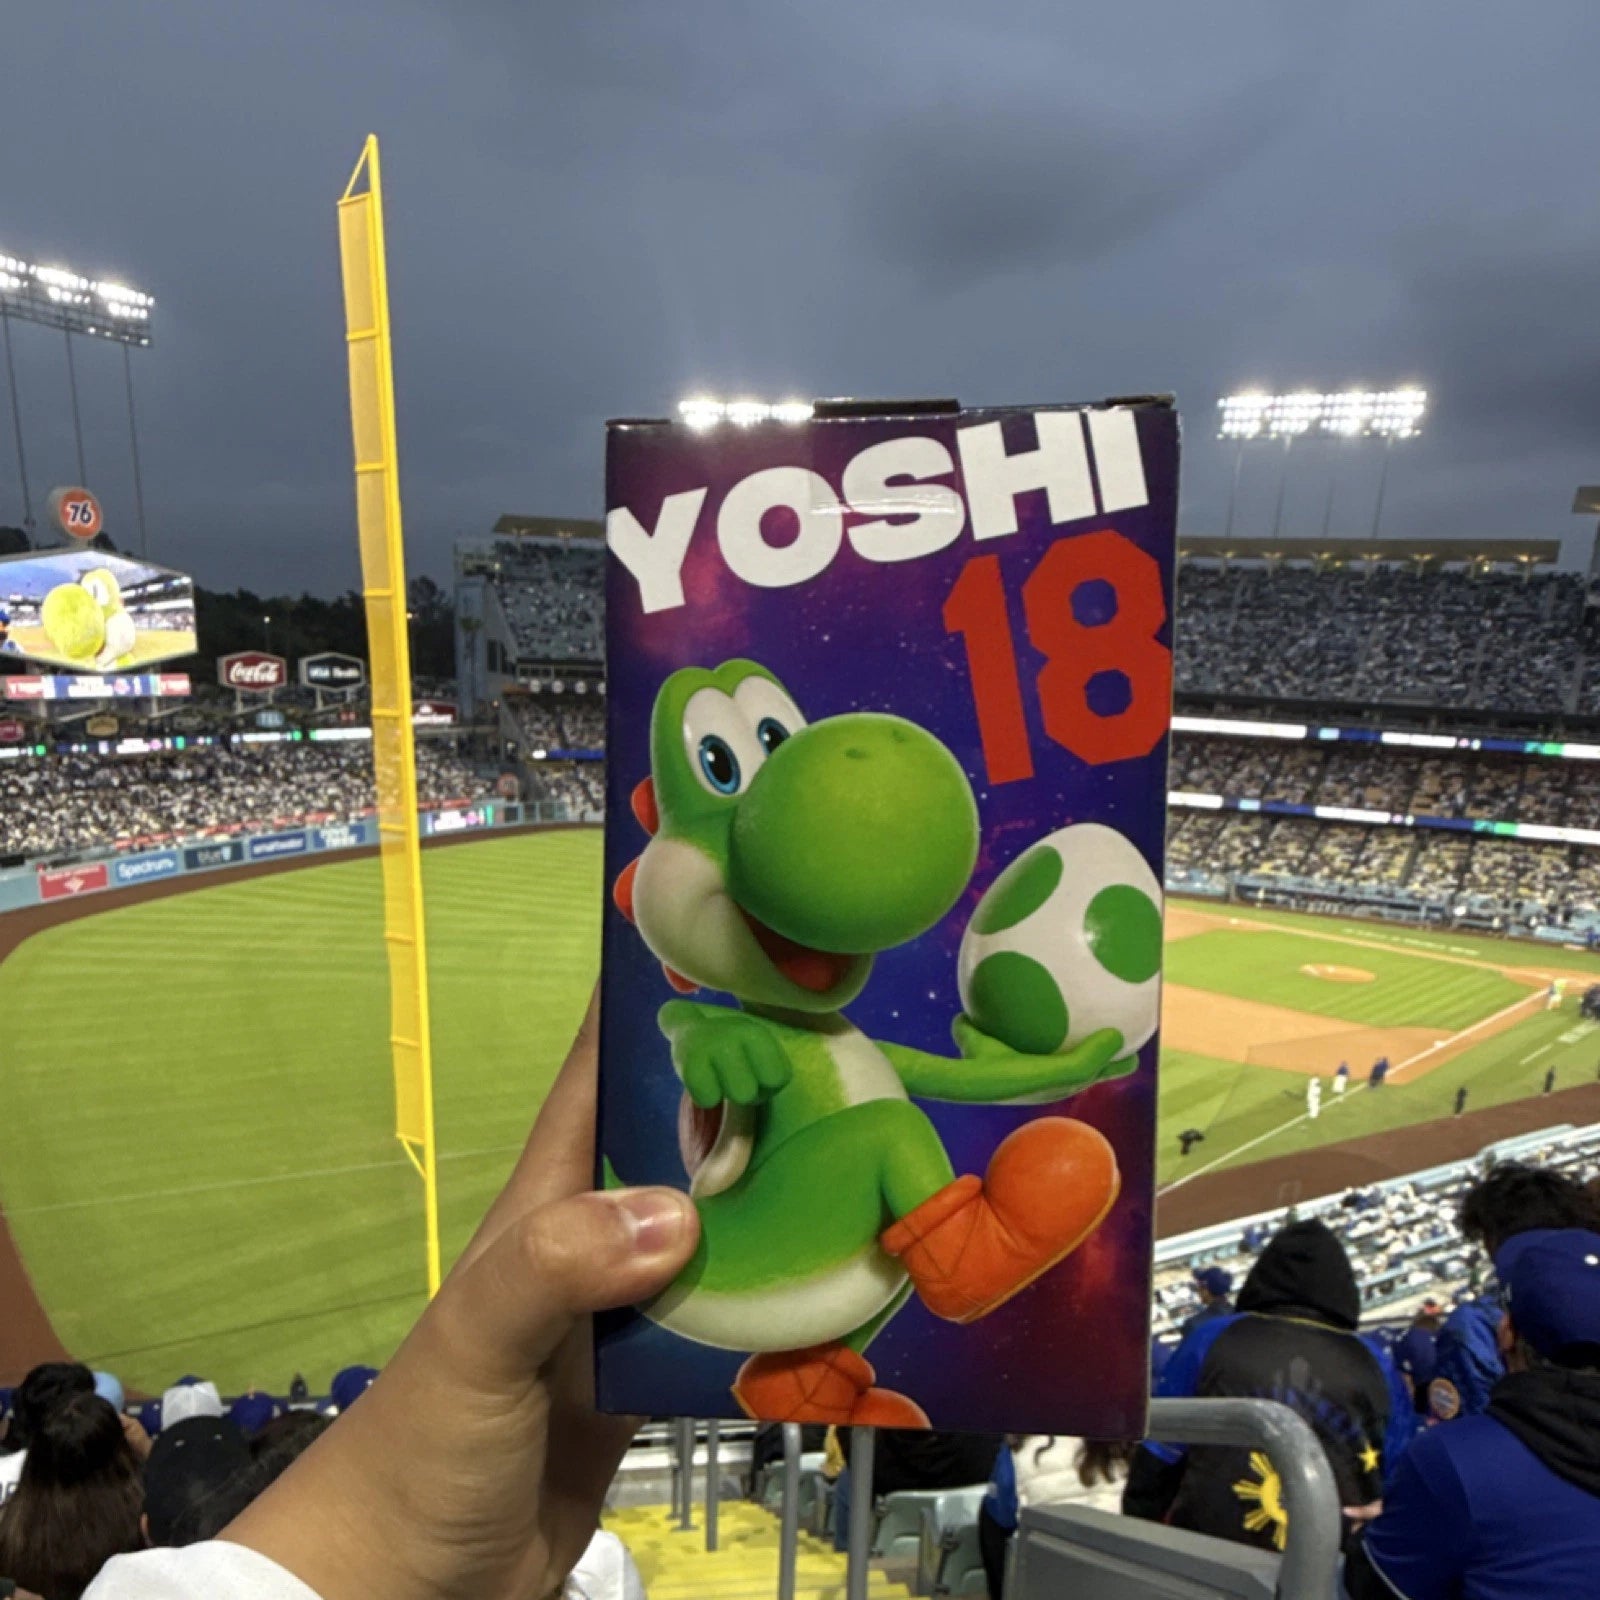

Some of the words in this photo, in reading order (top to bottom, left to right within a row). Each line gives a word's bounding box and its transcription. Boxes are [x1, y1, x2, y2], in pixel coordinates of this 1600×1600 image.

[67, 501, 95, 526] 76
[606, 411, 1149, 615] YOSHI
[943, 529, 1172, 785] 18
